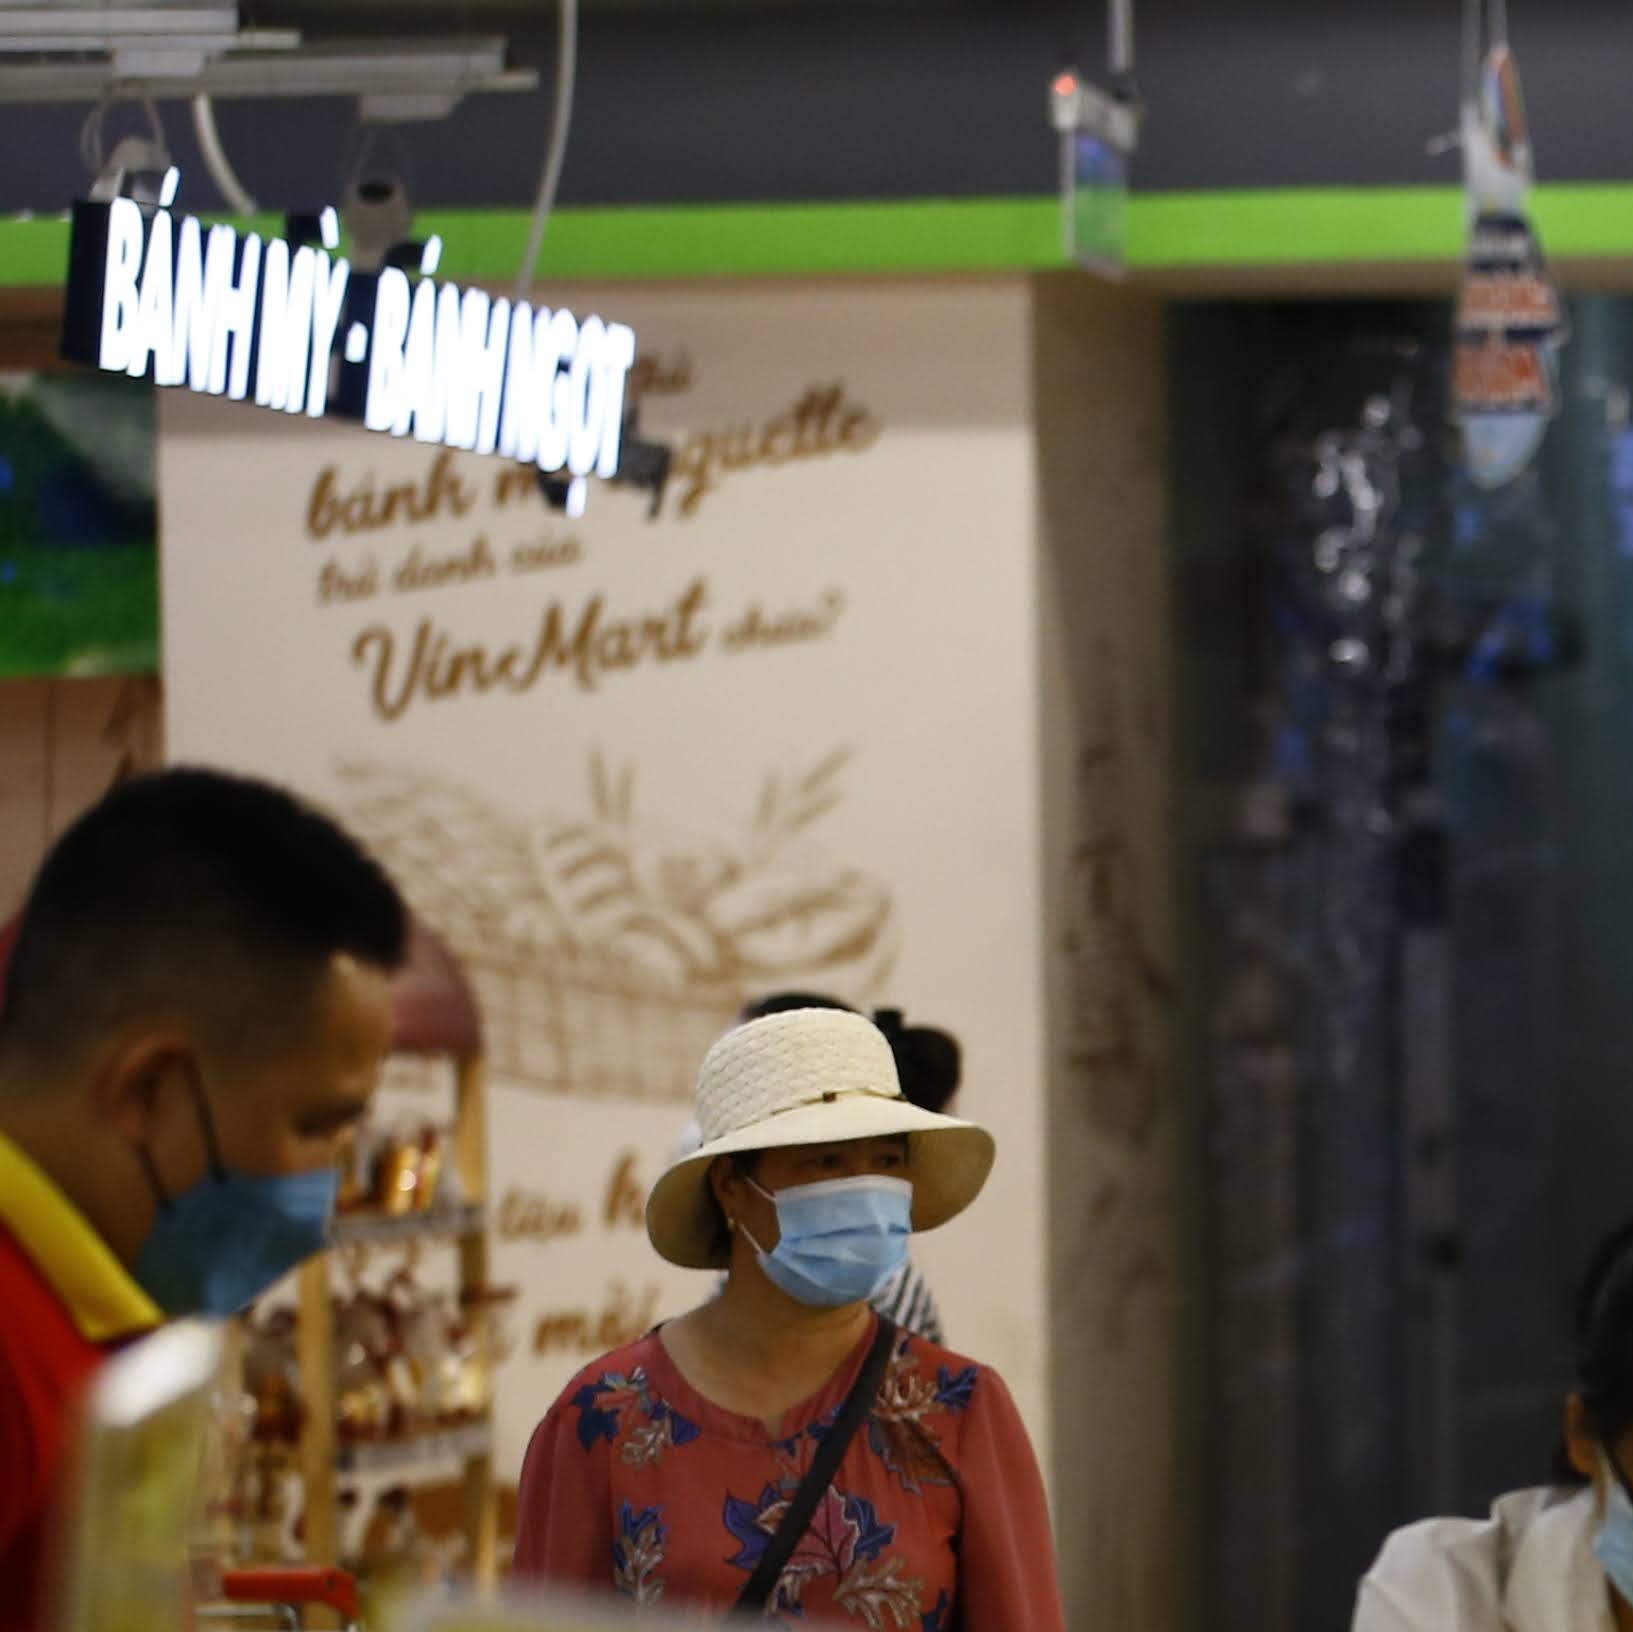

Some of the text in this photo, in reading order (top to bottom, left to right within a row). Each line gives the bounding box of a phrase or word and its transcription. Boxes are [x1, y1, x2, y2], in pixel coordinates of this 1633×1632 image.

[100, 166, 262, 400] BÁNH
[364, 235, 512, 456] BÁNH
[499, 300, 636, 518] NGỌT
